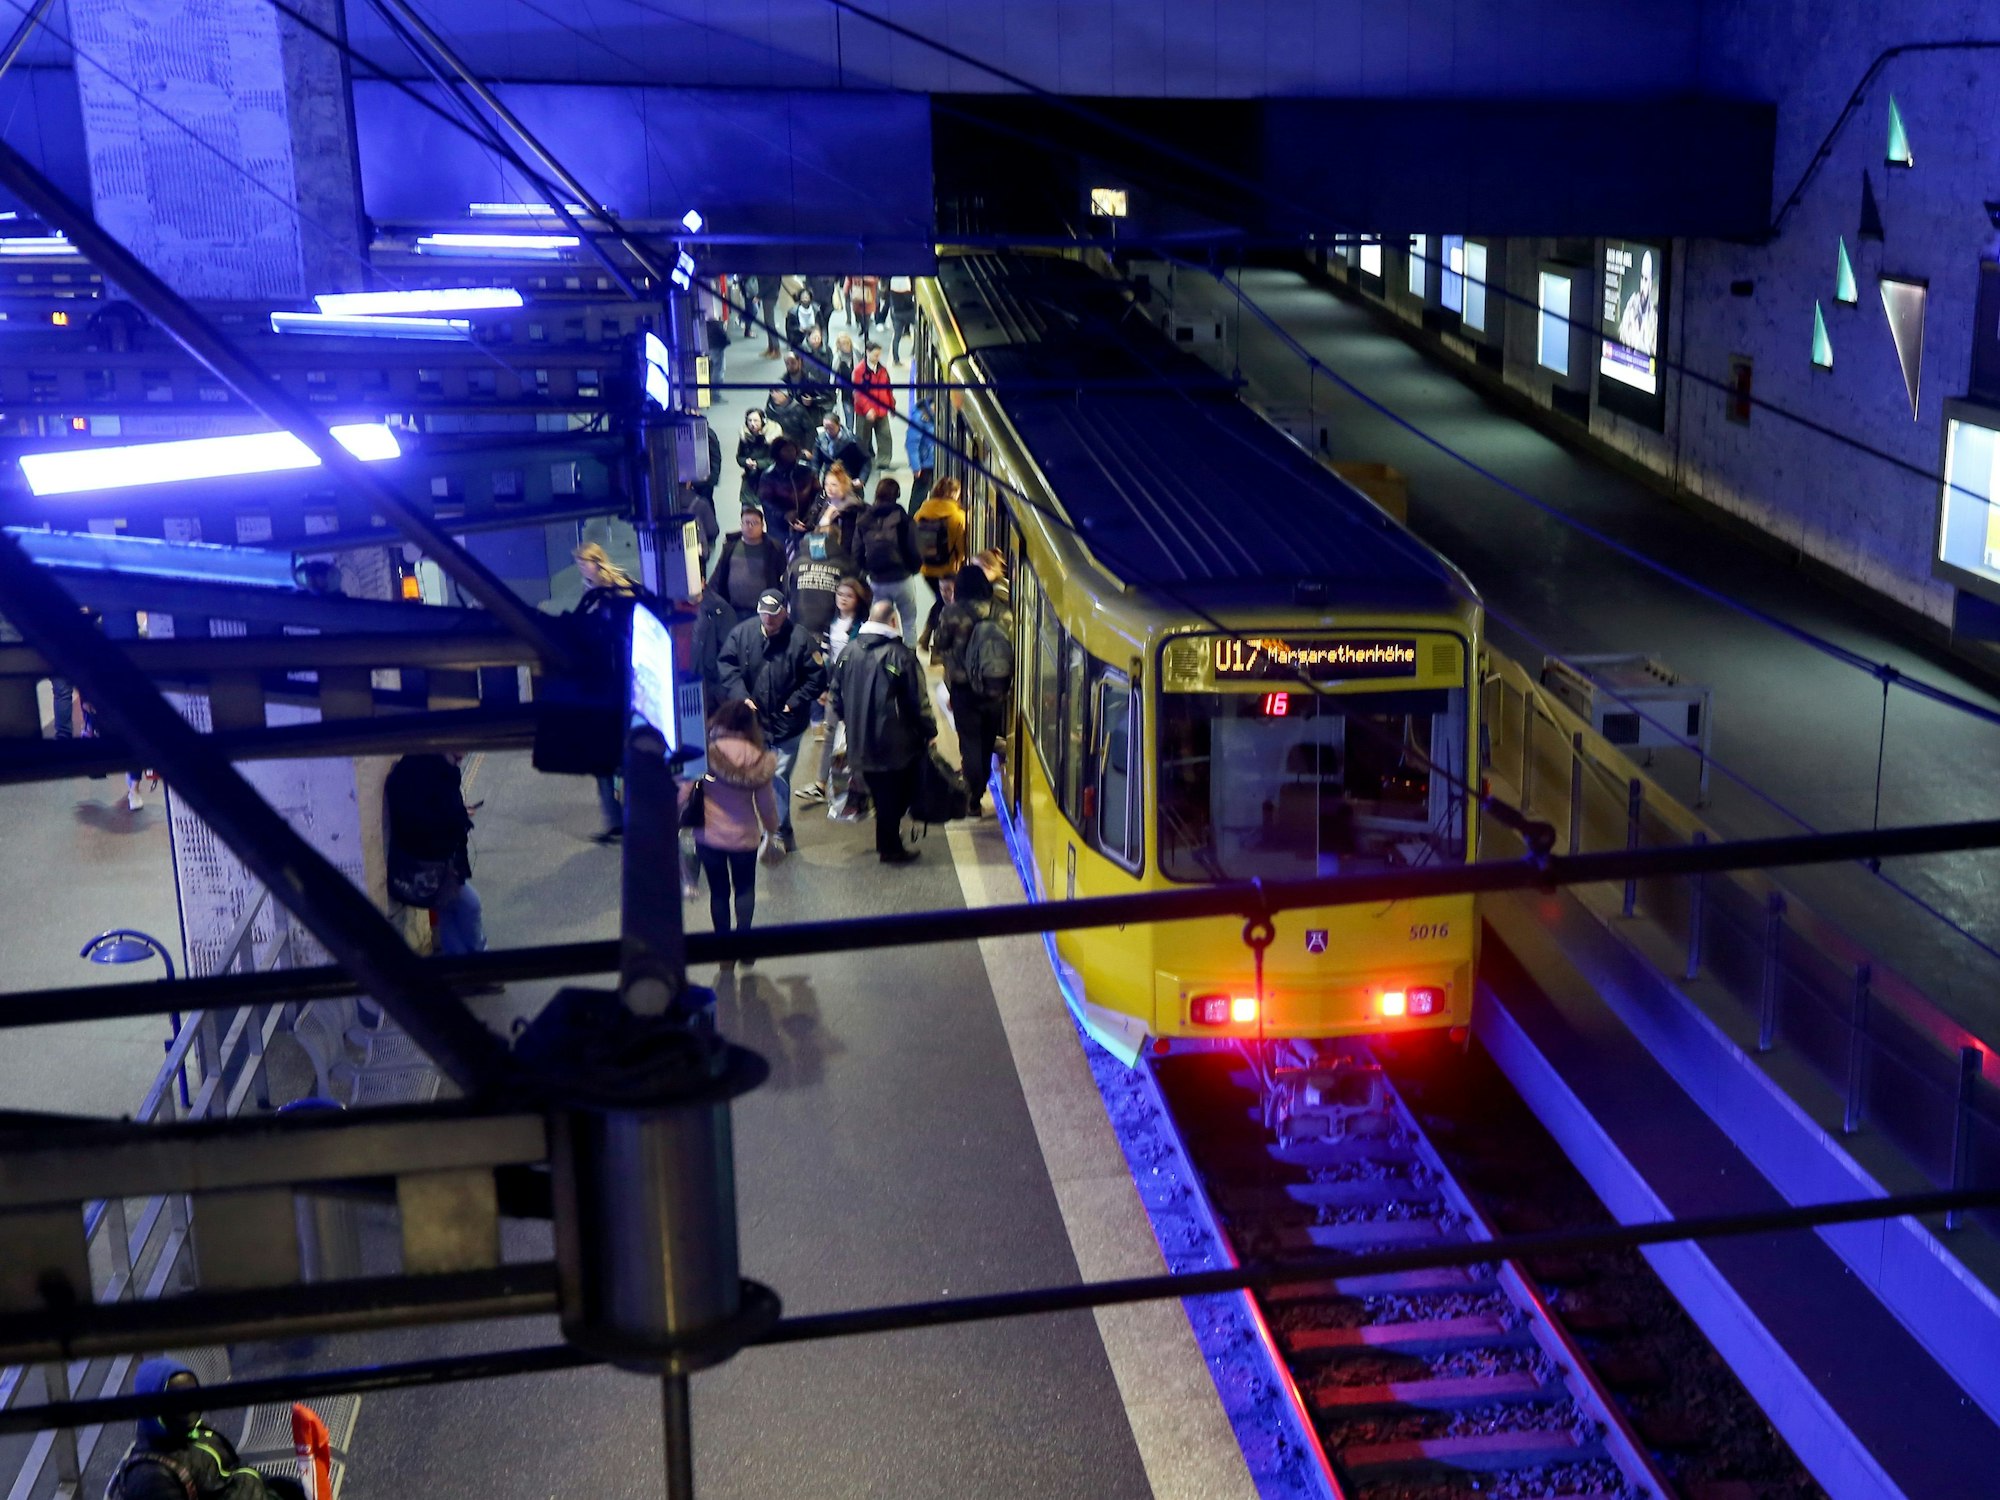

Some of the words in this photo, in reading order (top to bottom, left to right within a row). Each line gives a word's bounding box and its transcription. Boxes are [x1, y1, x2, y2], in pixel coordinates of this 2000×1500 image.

[1215, 639, 1261, 671] U17
[1267, 644, 1415, 665] Margarethenhöhe
[1265, 692, 1288, 715] 16
[1409, 922, 1449, 941] 5016
